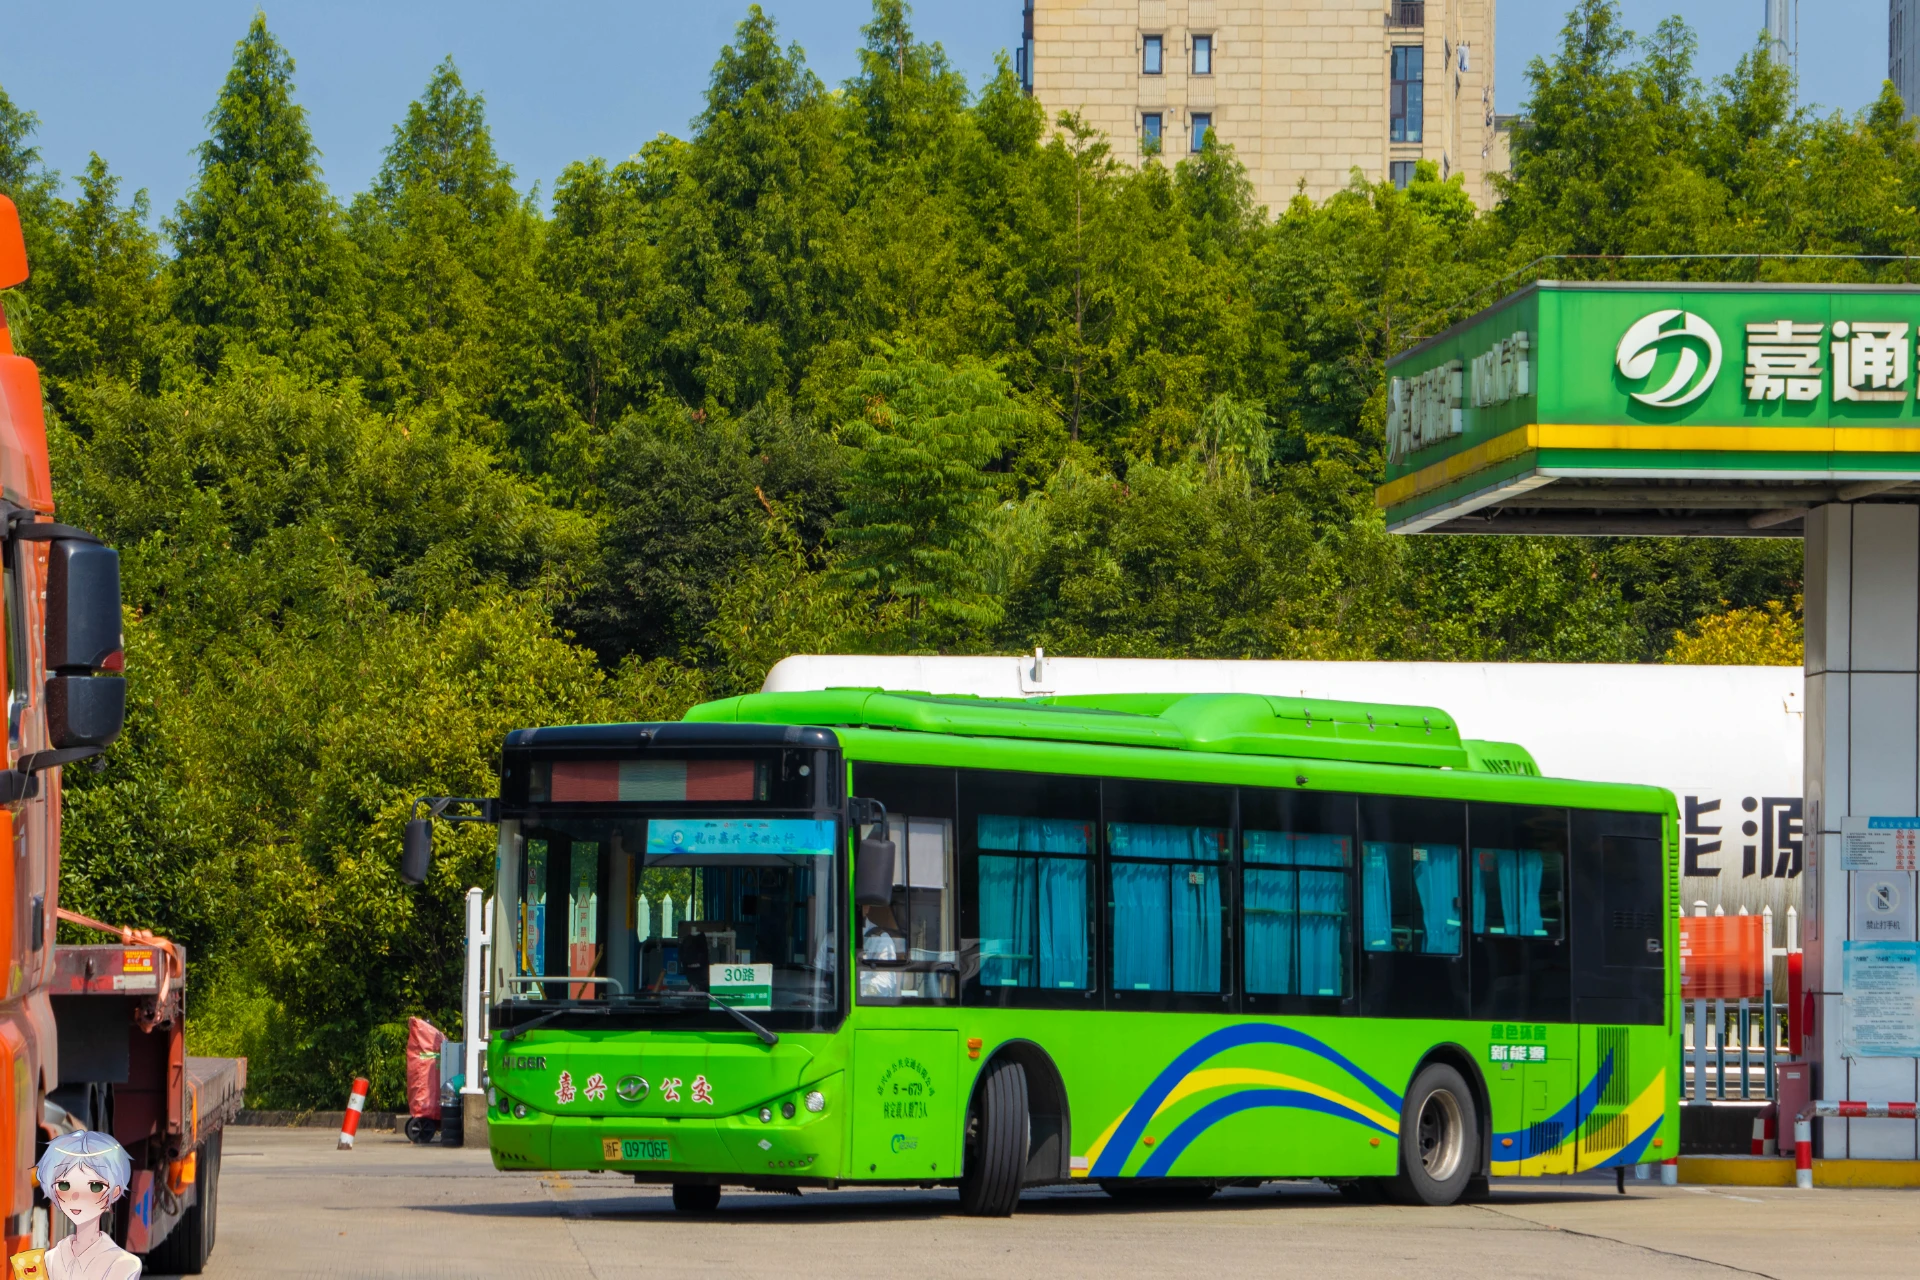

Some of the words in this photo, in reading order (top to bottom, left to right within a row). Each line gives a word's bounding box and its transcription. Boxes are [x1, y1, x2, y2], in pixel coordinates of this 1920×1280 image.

[1745, 320, 1920, 402] 嘉通
[1866, 920, 1900, 930] 禁止打手机
[724, 968, 755, 982] 30路
[1491, 1024, 1547, 1040] 绿色环保
[502, 1056, 547, 1070] HIGER
[555, 1070, 607, 1105] 嘉兴
[660, 1074, 714, 1105] 公交
